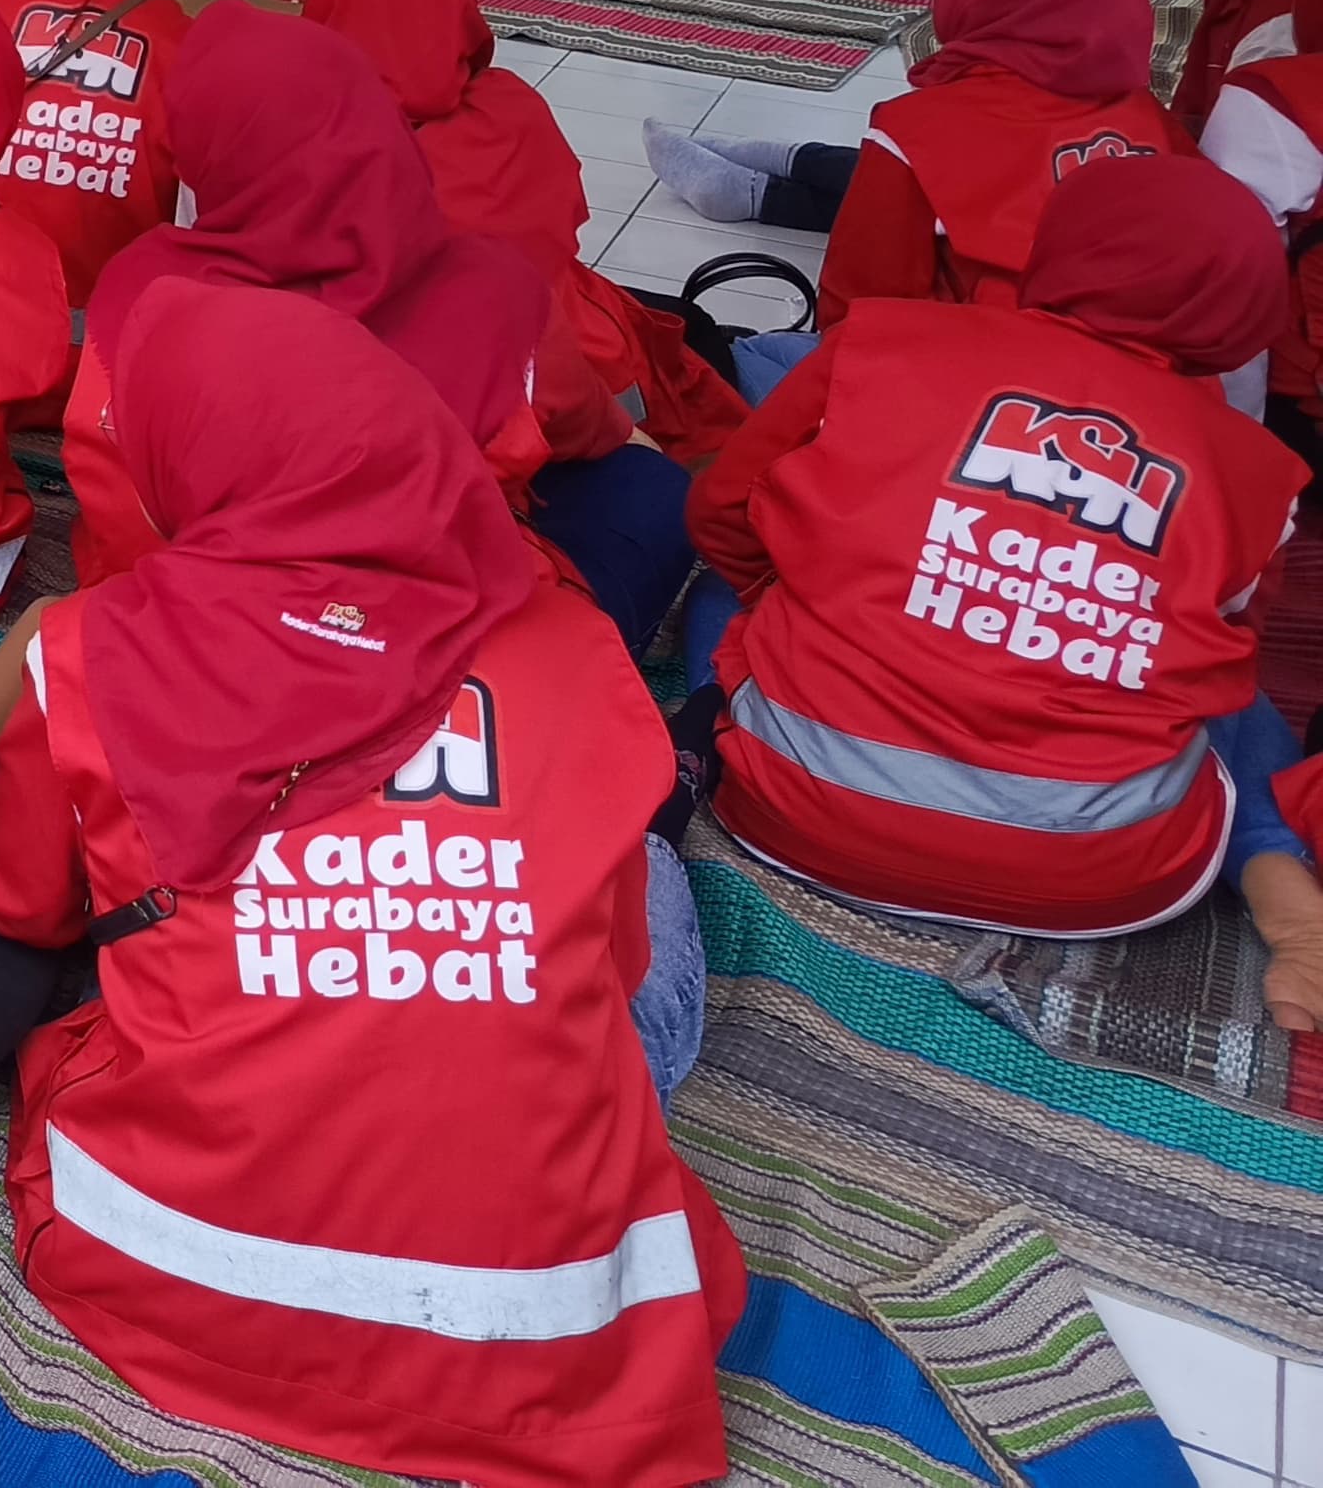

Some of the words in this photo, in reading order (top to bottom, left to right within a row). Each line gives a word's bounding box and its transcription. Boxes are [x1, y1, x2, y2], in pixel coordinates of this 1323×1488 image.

[11, 128, 136, 165] rabaya
[27, 100, 142, 142] ader
[925, 497, 1160, 612] Kader
[917, 543, 1164, 645] Surabaya
[904, 573, 1153, 690] Hebat
[232, 820, 524, 889] Kader
[233, 887, 534, 942] Surabaya
[235, 932, 536, 1004] Hebat
